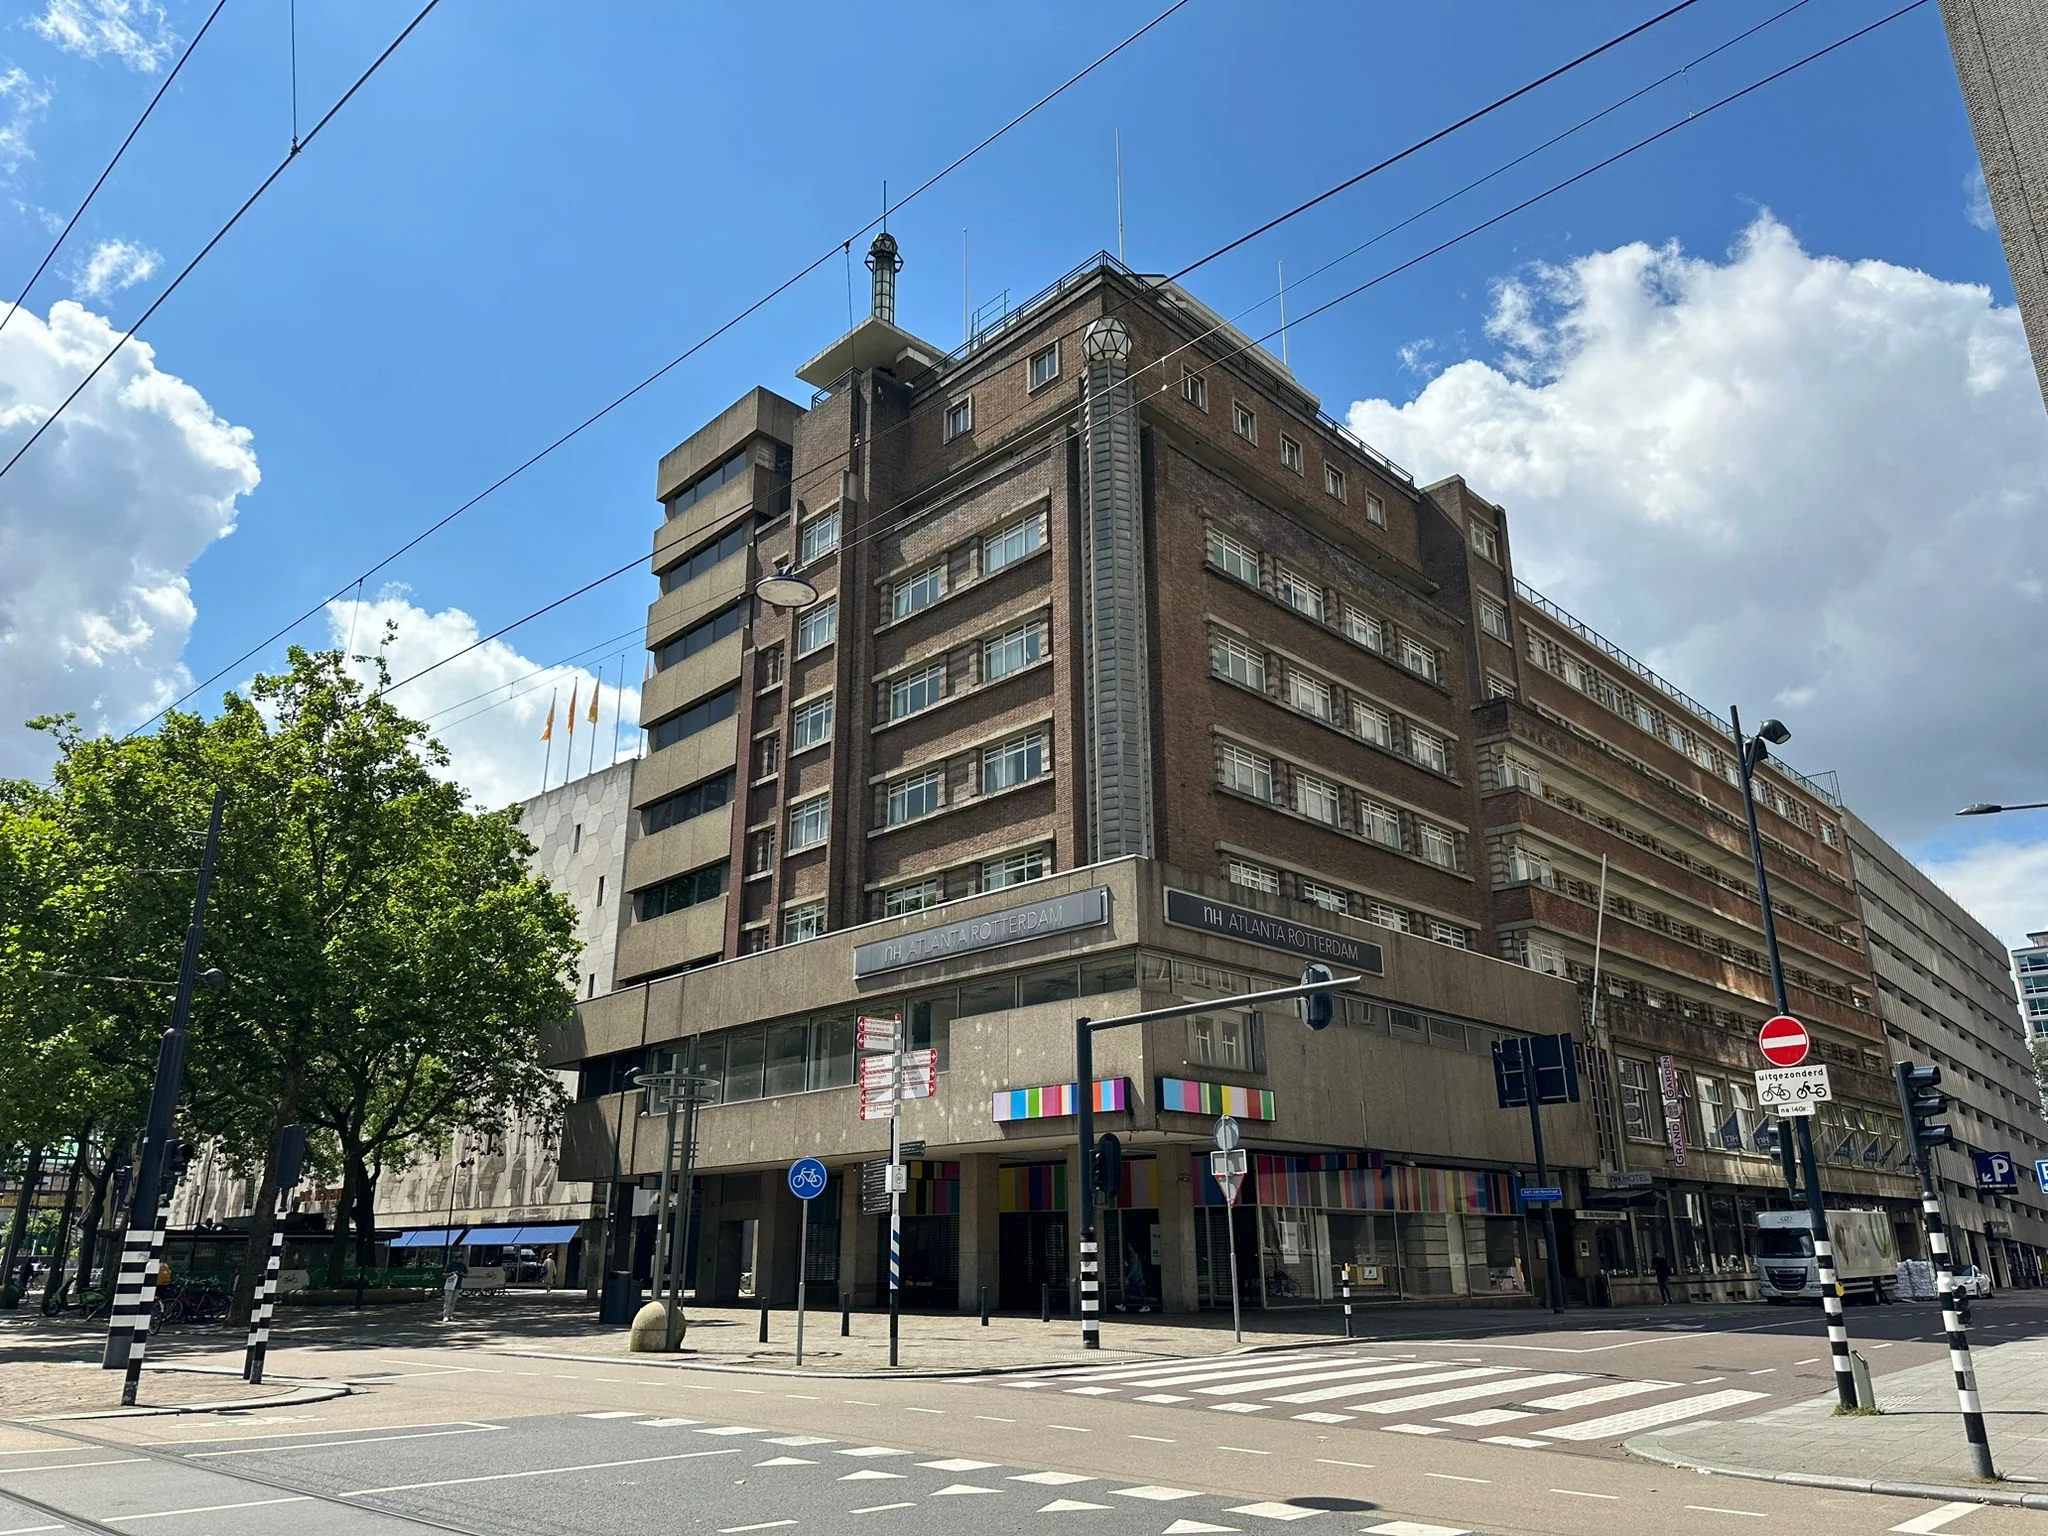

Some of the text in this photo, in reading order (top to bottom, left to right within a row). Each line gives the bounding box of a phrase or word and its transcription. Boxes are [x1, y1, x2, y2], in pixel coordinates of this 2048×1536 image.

[907, 928, 967, 958] ATLANTA
[970, 904, 1063, 941] ROTTERDAM
[1228, 912, 1286, 943] ATLANTA
[1288, 927, 1359, 961] ROTTERDAM
[1662, 1056, 1675, 1098] GARDEN
[1758, 1068, 1824, 1082] uitgezonderd
[1672, 1123, 1685, 1165] GRAND
[1623, 1173, 1650, 1182] HOTEL
[1991, 1159, 2009, 1182] P
